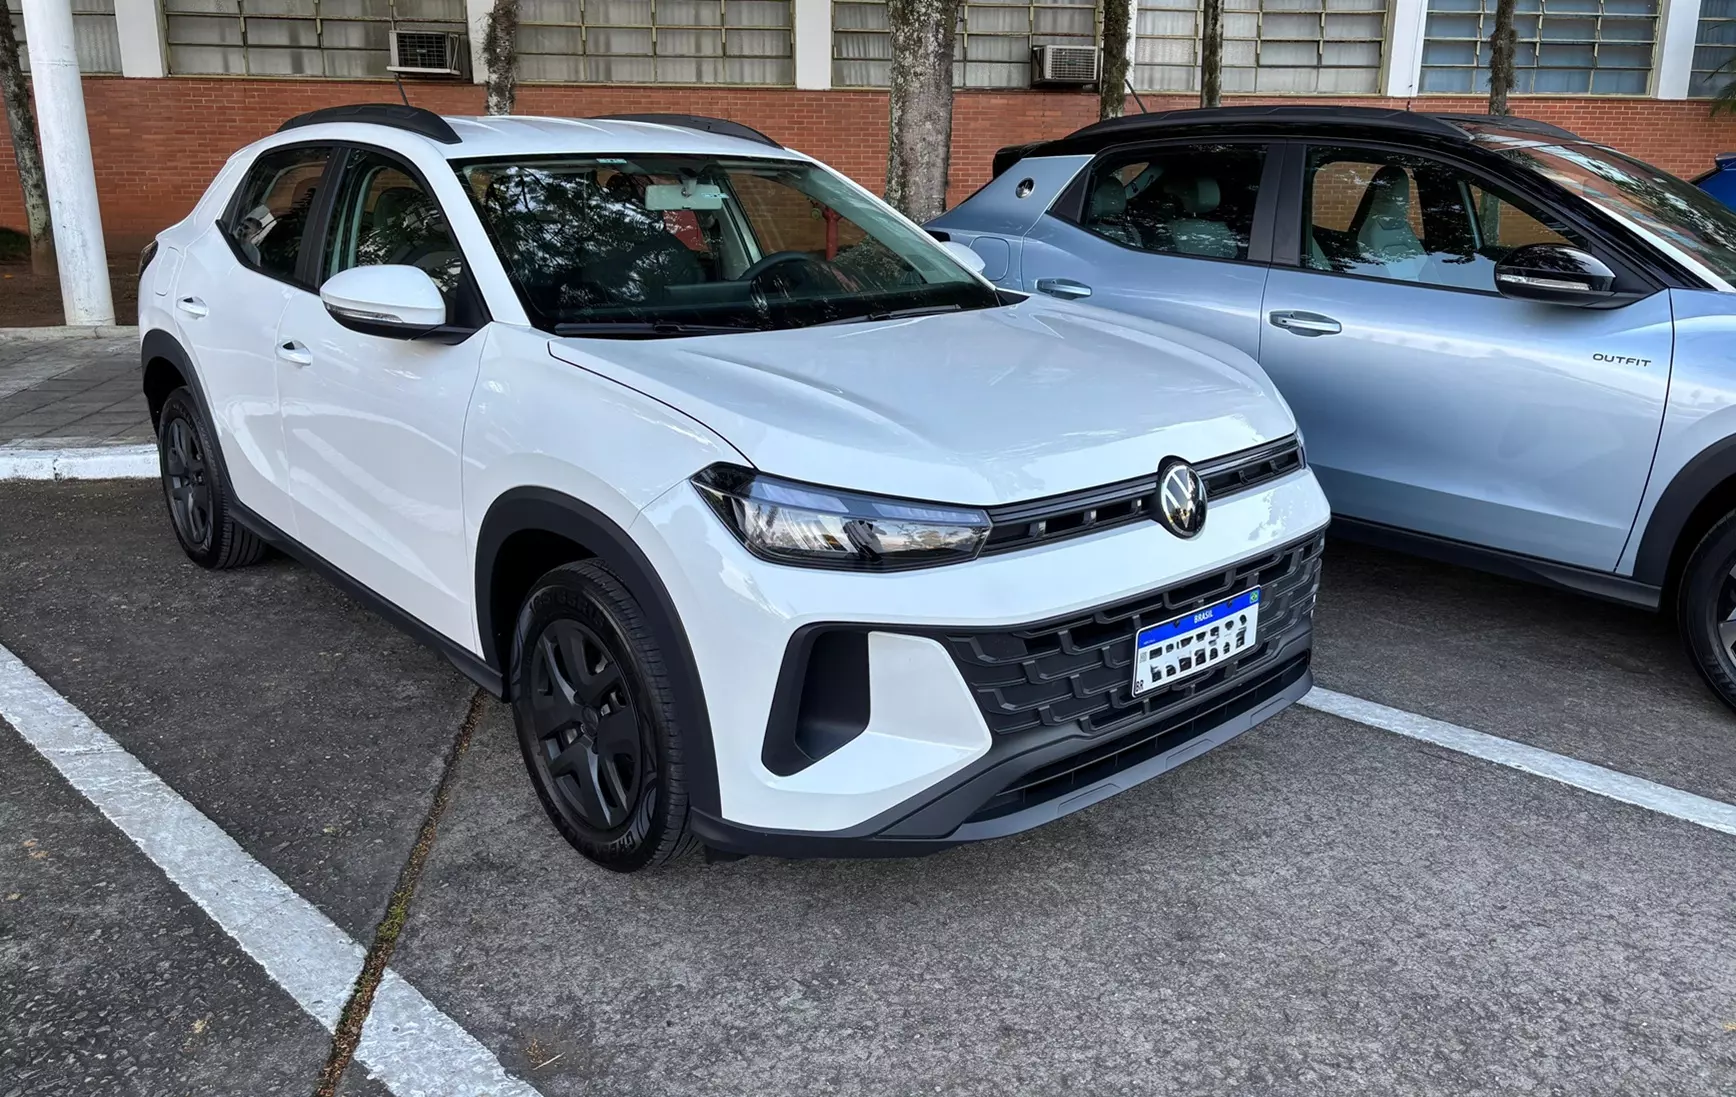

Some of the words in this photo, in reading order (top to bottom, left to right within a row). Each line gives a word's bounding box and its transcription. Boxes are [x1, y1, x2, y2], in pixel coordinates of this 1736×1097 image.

[1592, 353, 1652, 367] OUTFIT
[1193, 609, 1213, 624] BRASIL
[1134, 679, 1144, 693] BR
